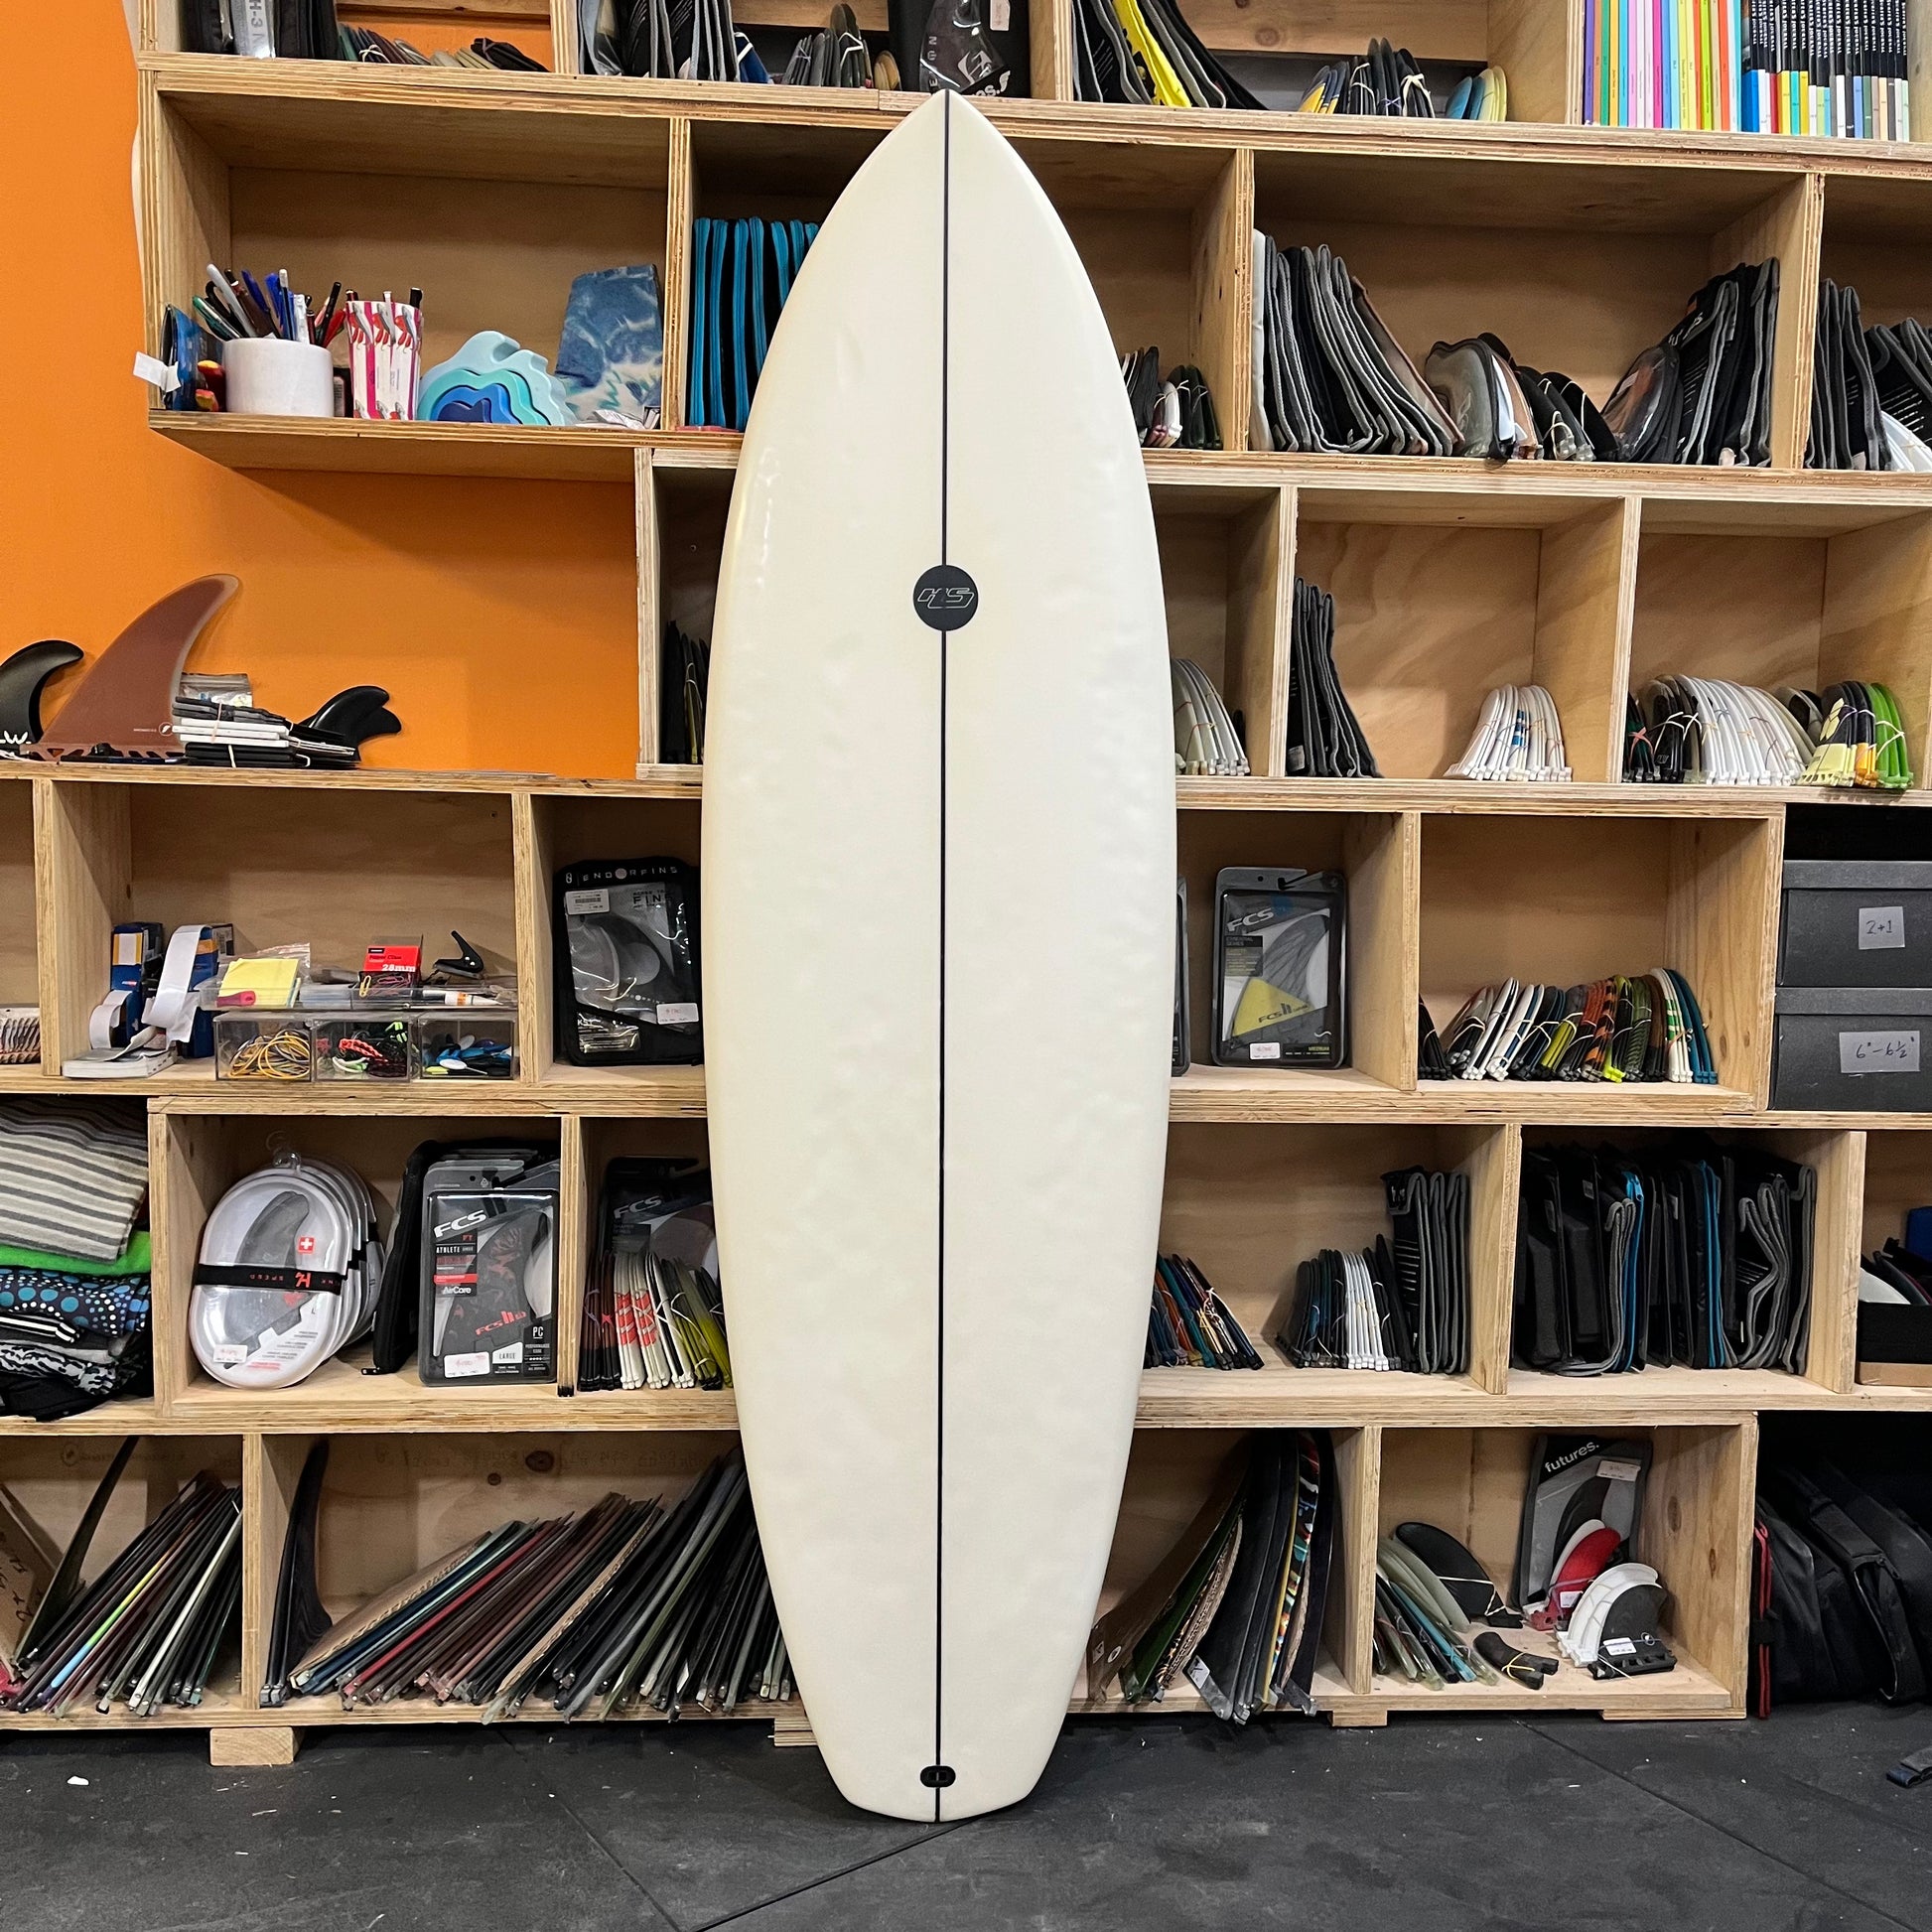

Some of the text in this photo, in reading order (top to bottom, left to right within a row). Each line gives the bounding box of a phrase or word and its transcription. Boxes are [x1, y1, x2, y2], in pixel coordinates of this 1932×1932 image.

[1226, 906, 1275, 933] FCS
[1865, 919, 1893, 935] 2+1
[613, 1195, 662, 1219] FCS
[433, 1209, 486, 1238] FCS
[532, 1325, 544, 1337] PC
[1544, 1441, 1600, 1472] futures.
